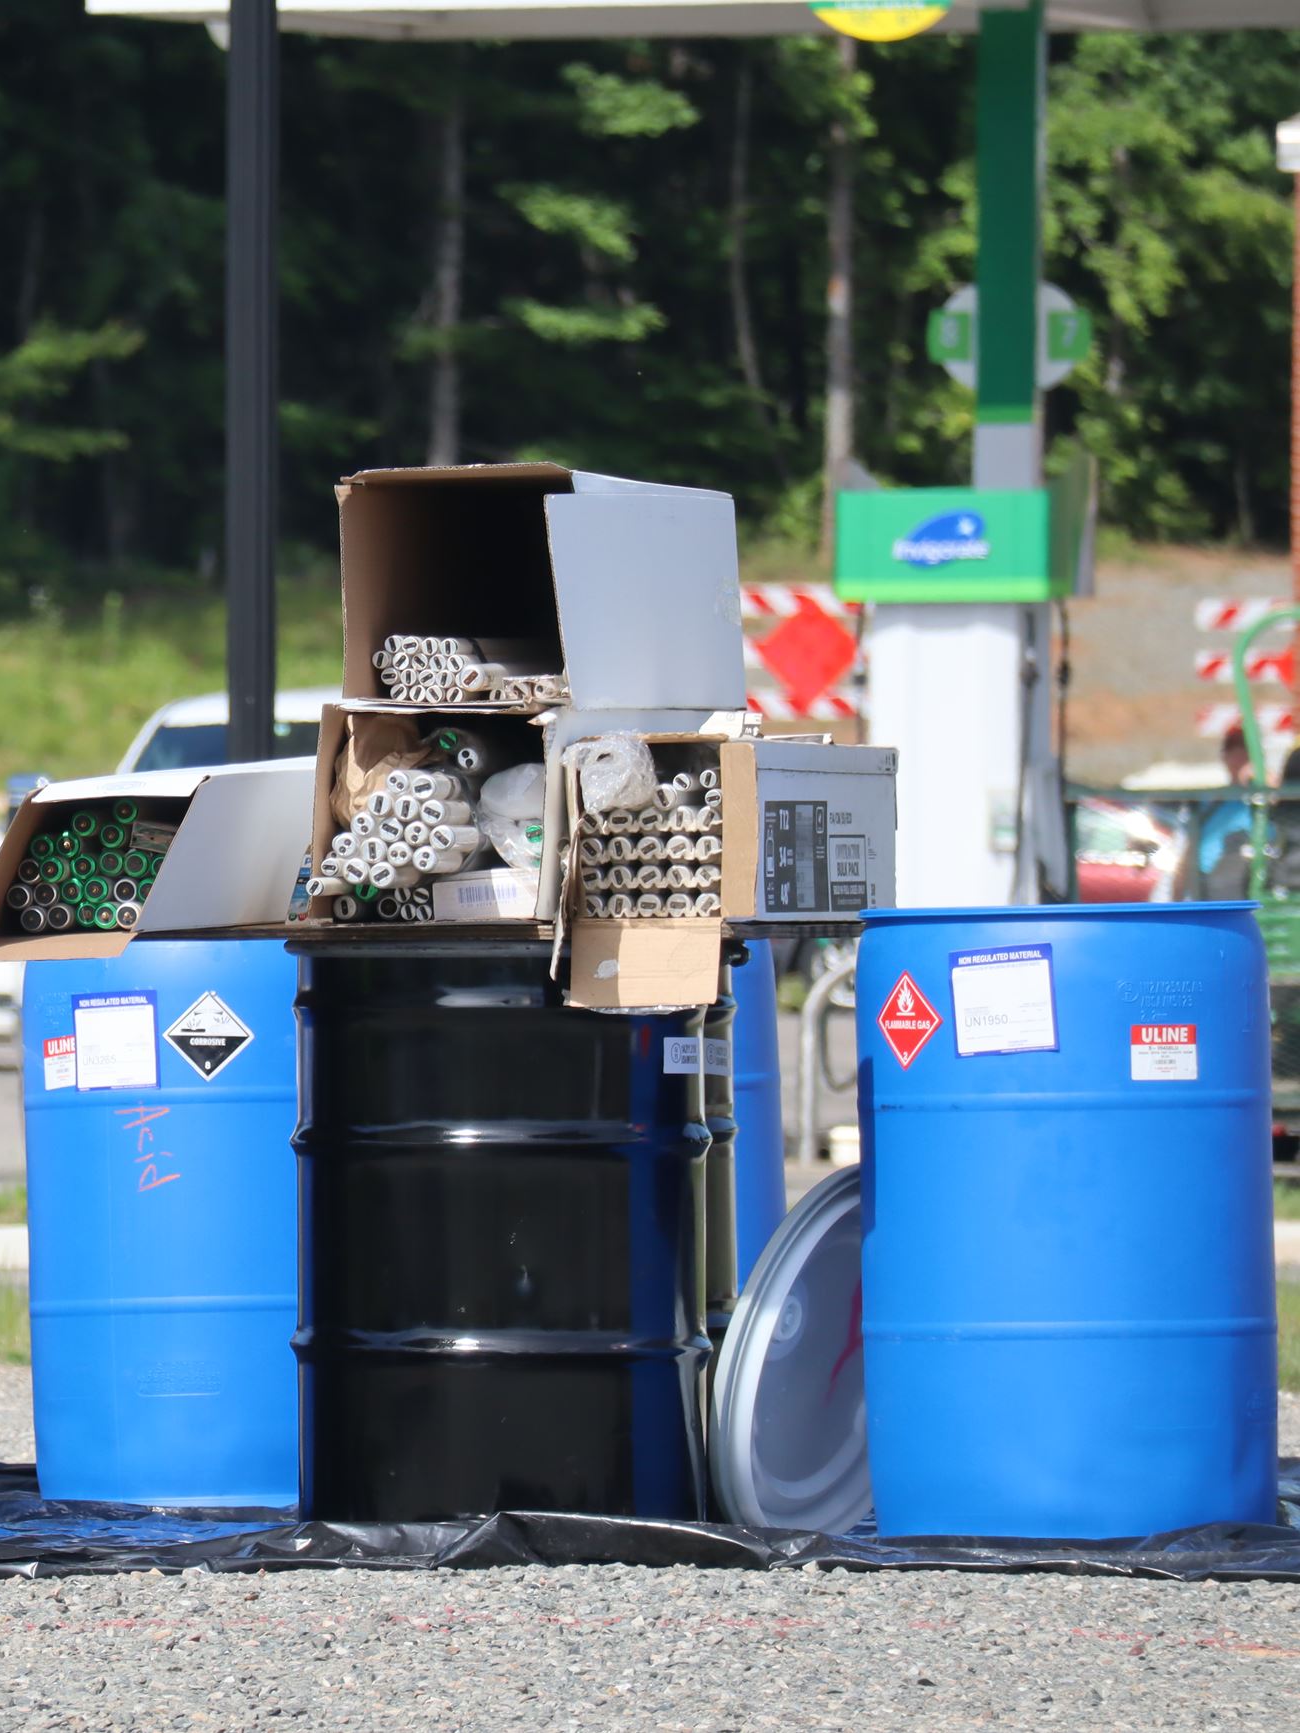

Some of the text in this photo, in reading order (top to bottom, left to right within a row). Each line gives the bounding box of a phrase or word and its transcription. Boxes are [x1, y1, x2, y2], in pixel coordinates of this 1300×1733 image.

[958, 950, 1042, 965] NON REGULATED MATERIAL
[79, 996, 148, 1007] NON REGULATED MATERIAL
[885, 1020, 930, 1029] FLAMMABLE GAS
[964, 1014, 1008, 1028] UN1950
[1141, 1027, 1188, 1043] ULINE
[48, 1036, 76, 1055] ULINE
[190, 1037, 226, 1046] CORROSIVE
[902, 1051, 909, 1061] 2
[204, 1061, 211, 1070] 8
